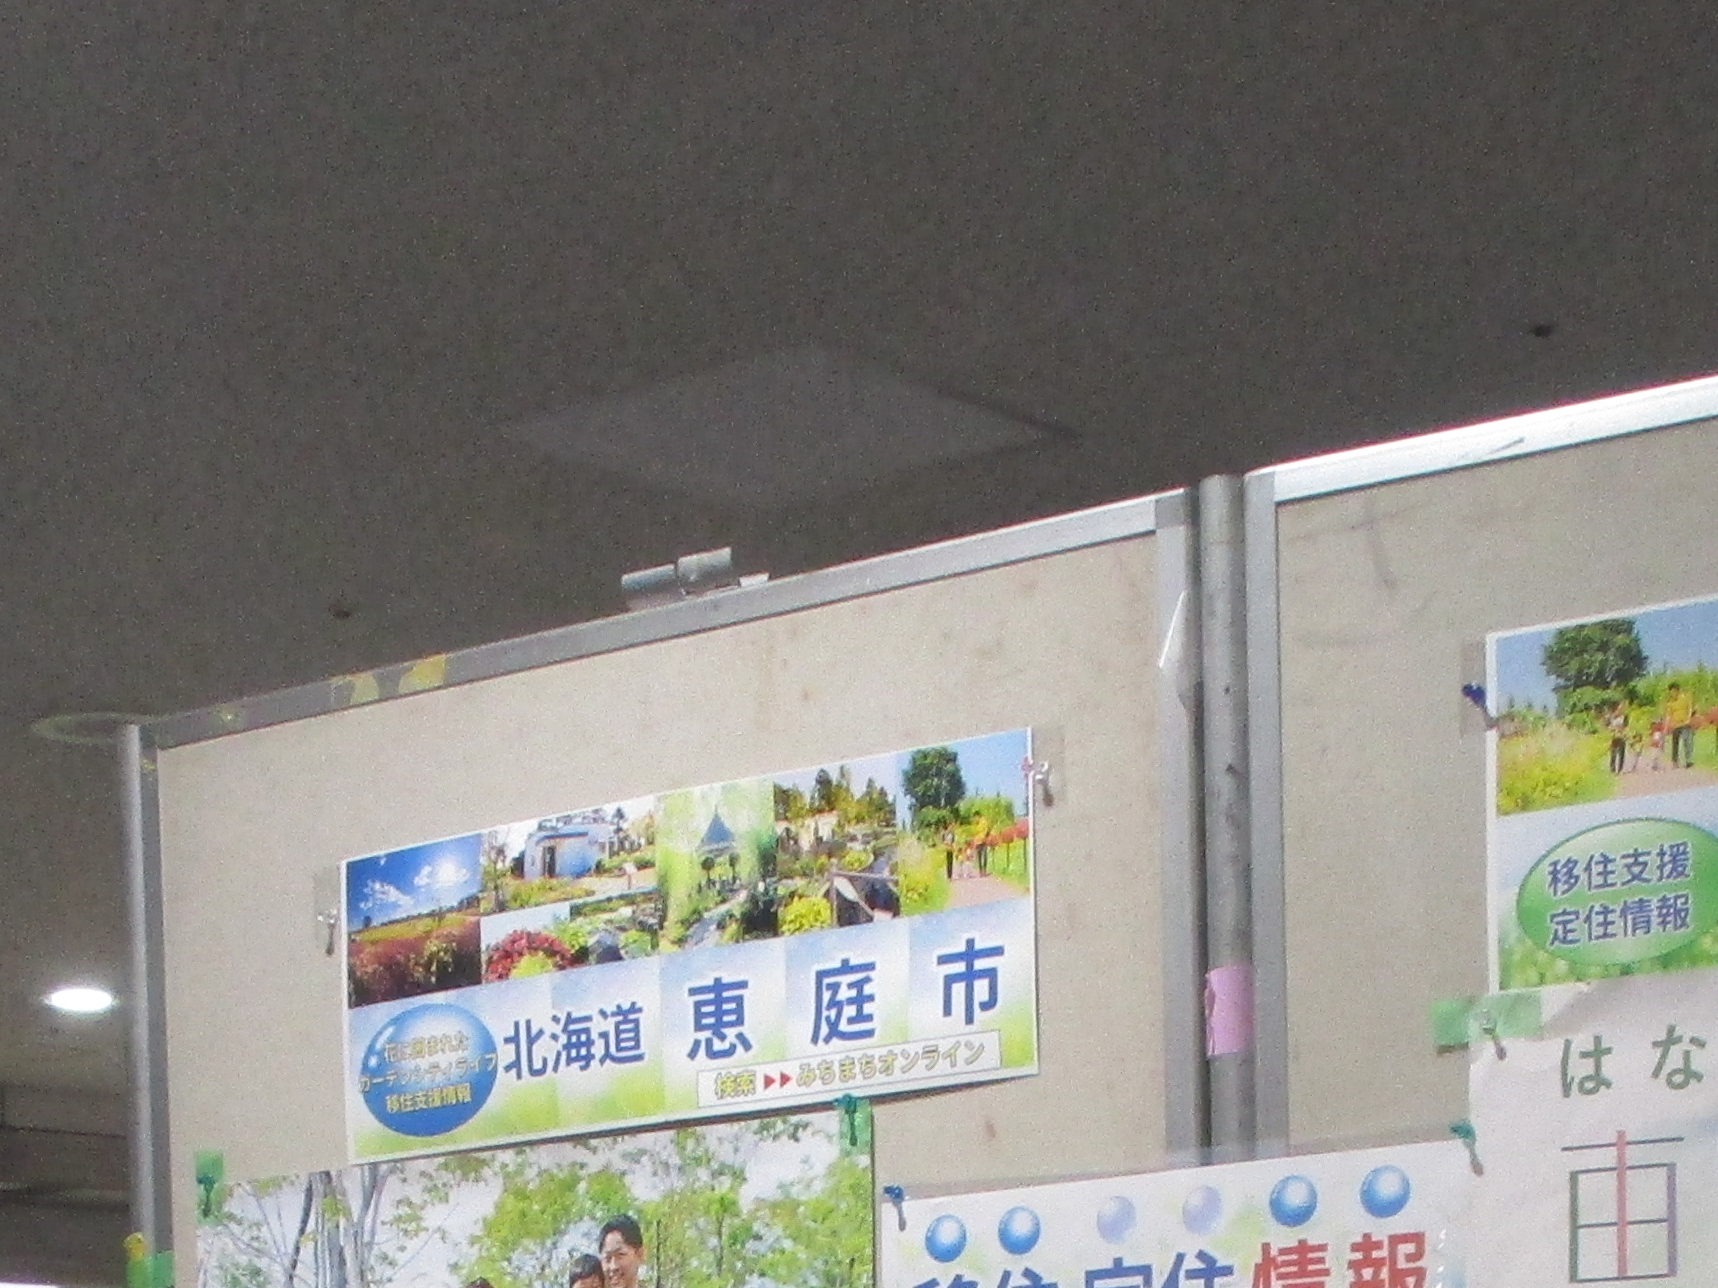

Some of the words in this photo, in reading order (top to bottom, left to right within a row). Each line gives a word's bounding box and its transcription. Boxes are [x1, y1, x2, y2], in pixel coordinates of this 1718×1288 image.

[1547, 841, 1691, 894] 移住支援
[1549, 893, 1691, 947] 定住情報
[503, 1000, 645, 1080] 北海道
[686, 937, 1007, 1061] 恵庭市
[714, 1070, 757, 1100] 検索
[795, 1039, 985, 1088] みちまちオンライン
